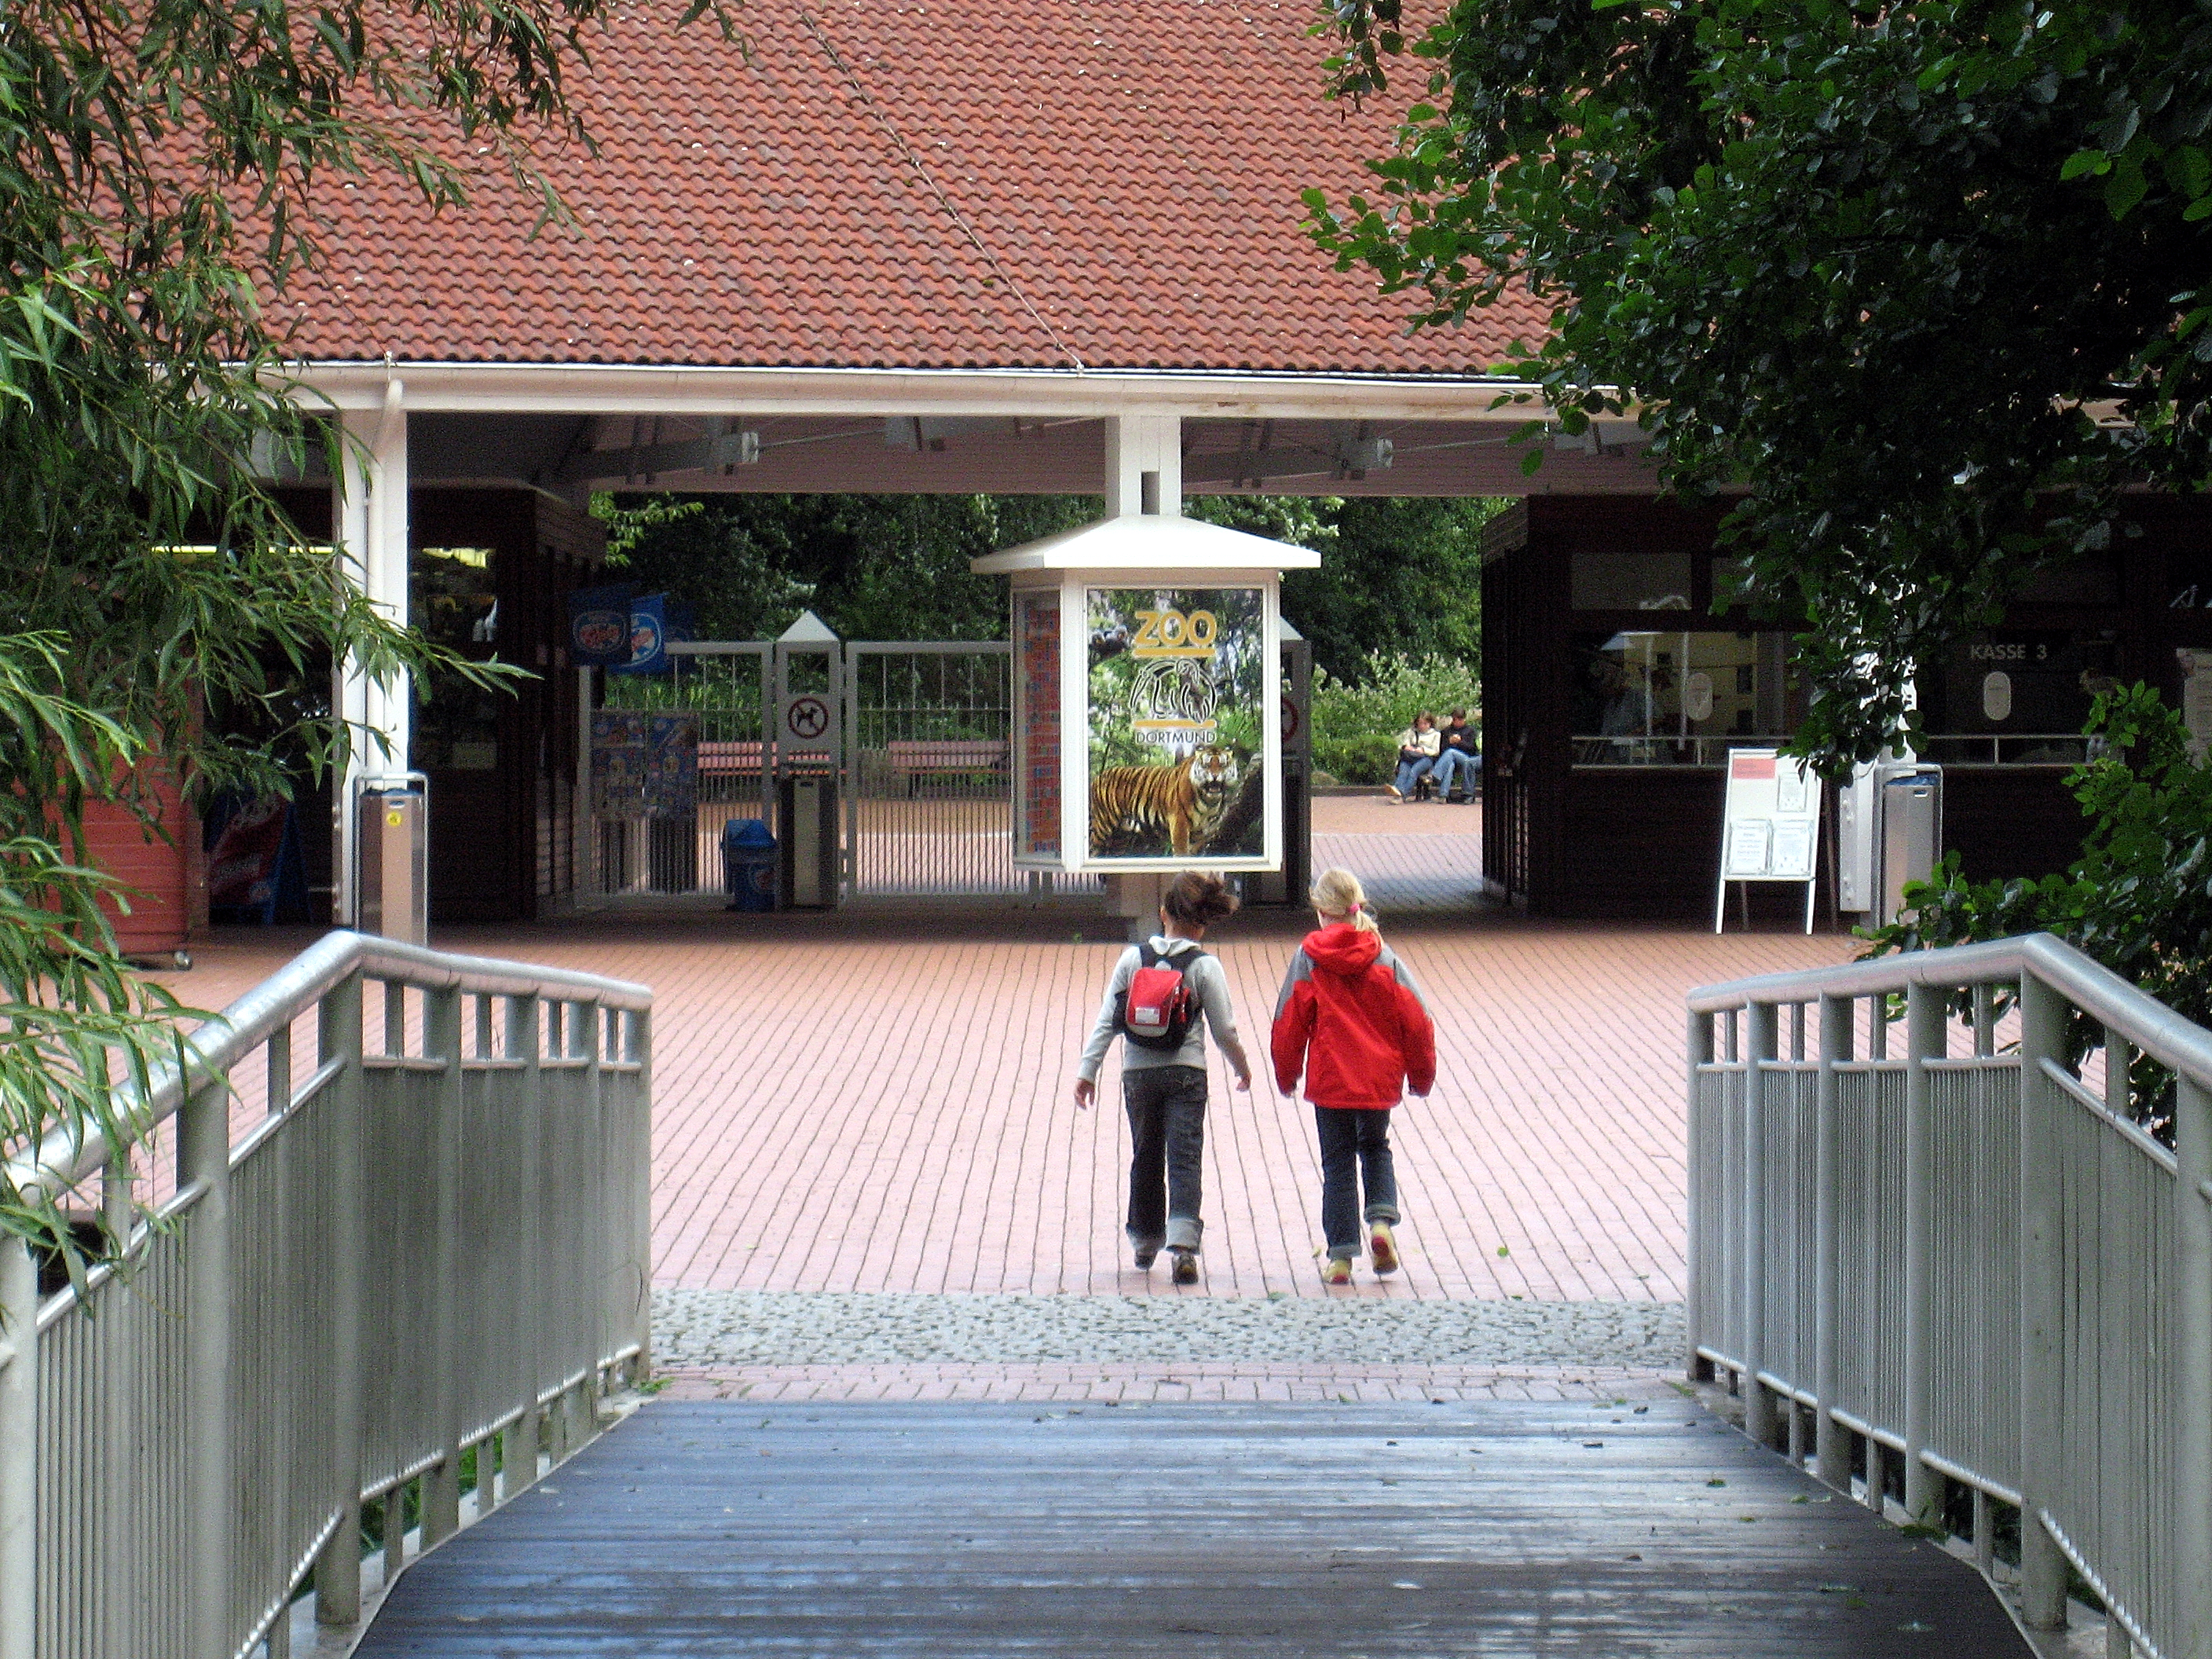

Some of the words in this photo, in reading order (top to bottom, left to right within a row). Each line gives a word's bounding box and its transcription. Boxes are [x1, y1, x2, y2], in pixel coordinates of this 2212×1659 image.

[1134, 610, 1217, 646] ZOO
[1970, 644, 2027, 659] KASSE
[2036, 644, 2047, 660] 3
[1136, 731, 1215, 744] DORTMUND
